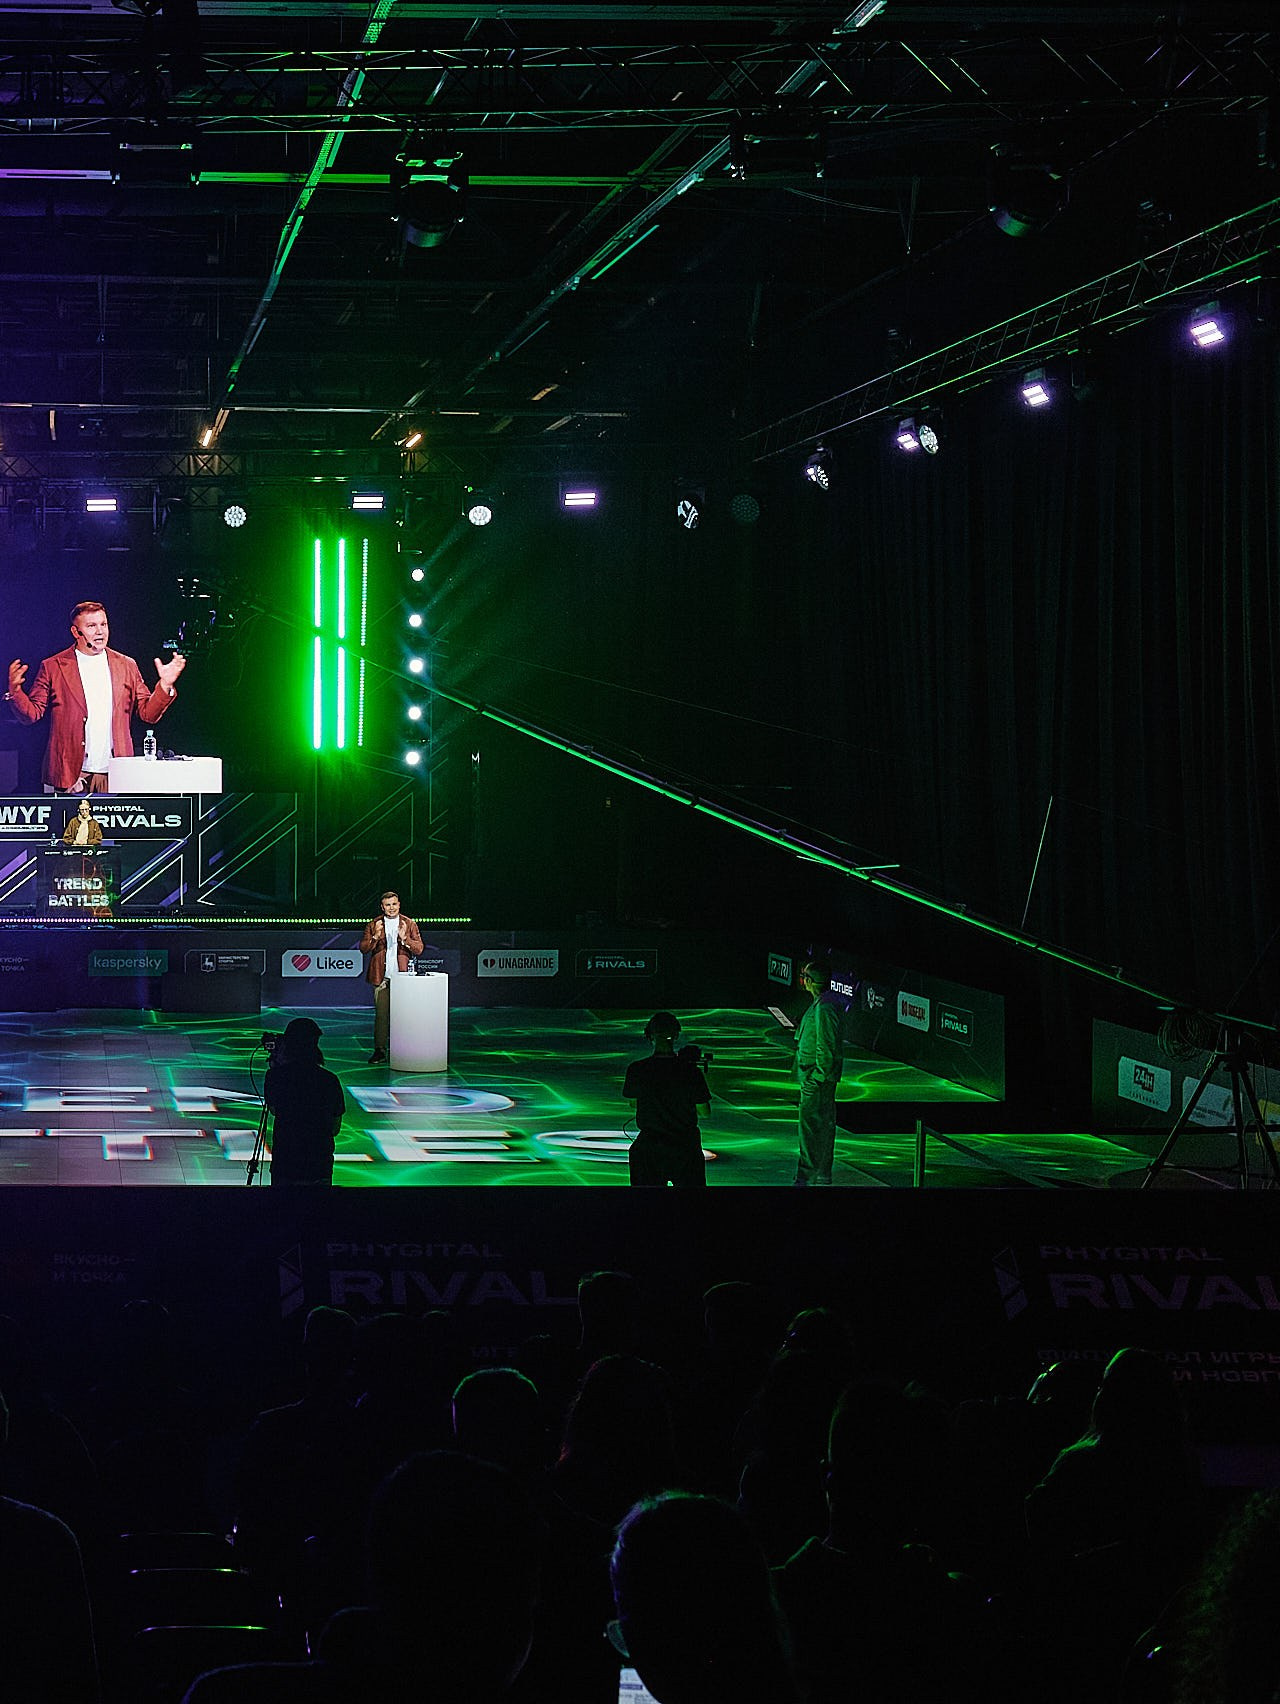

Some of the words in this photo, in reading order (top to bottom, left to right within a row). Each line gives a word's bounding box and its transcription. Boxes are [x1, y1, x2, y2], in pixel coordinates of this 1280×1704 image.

[94, 814, 182, 828] RIVALS
[54, 877, 103, 890] TREND
[48, 894, 110, 907] BATTLES
[93, 955, 163, 970] kaspersky
[316, 957, 354, 970] Likee
[498, 957, 554, 969] UNAGRANDE
[594, 961, 646, 969] RIVALS
[944, 1018, 968, 1034] RIVALS
[328, 1270, 579, 1306] RIVAL
